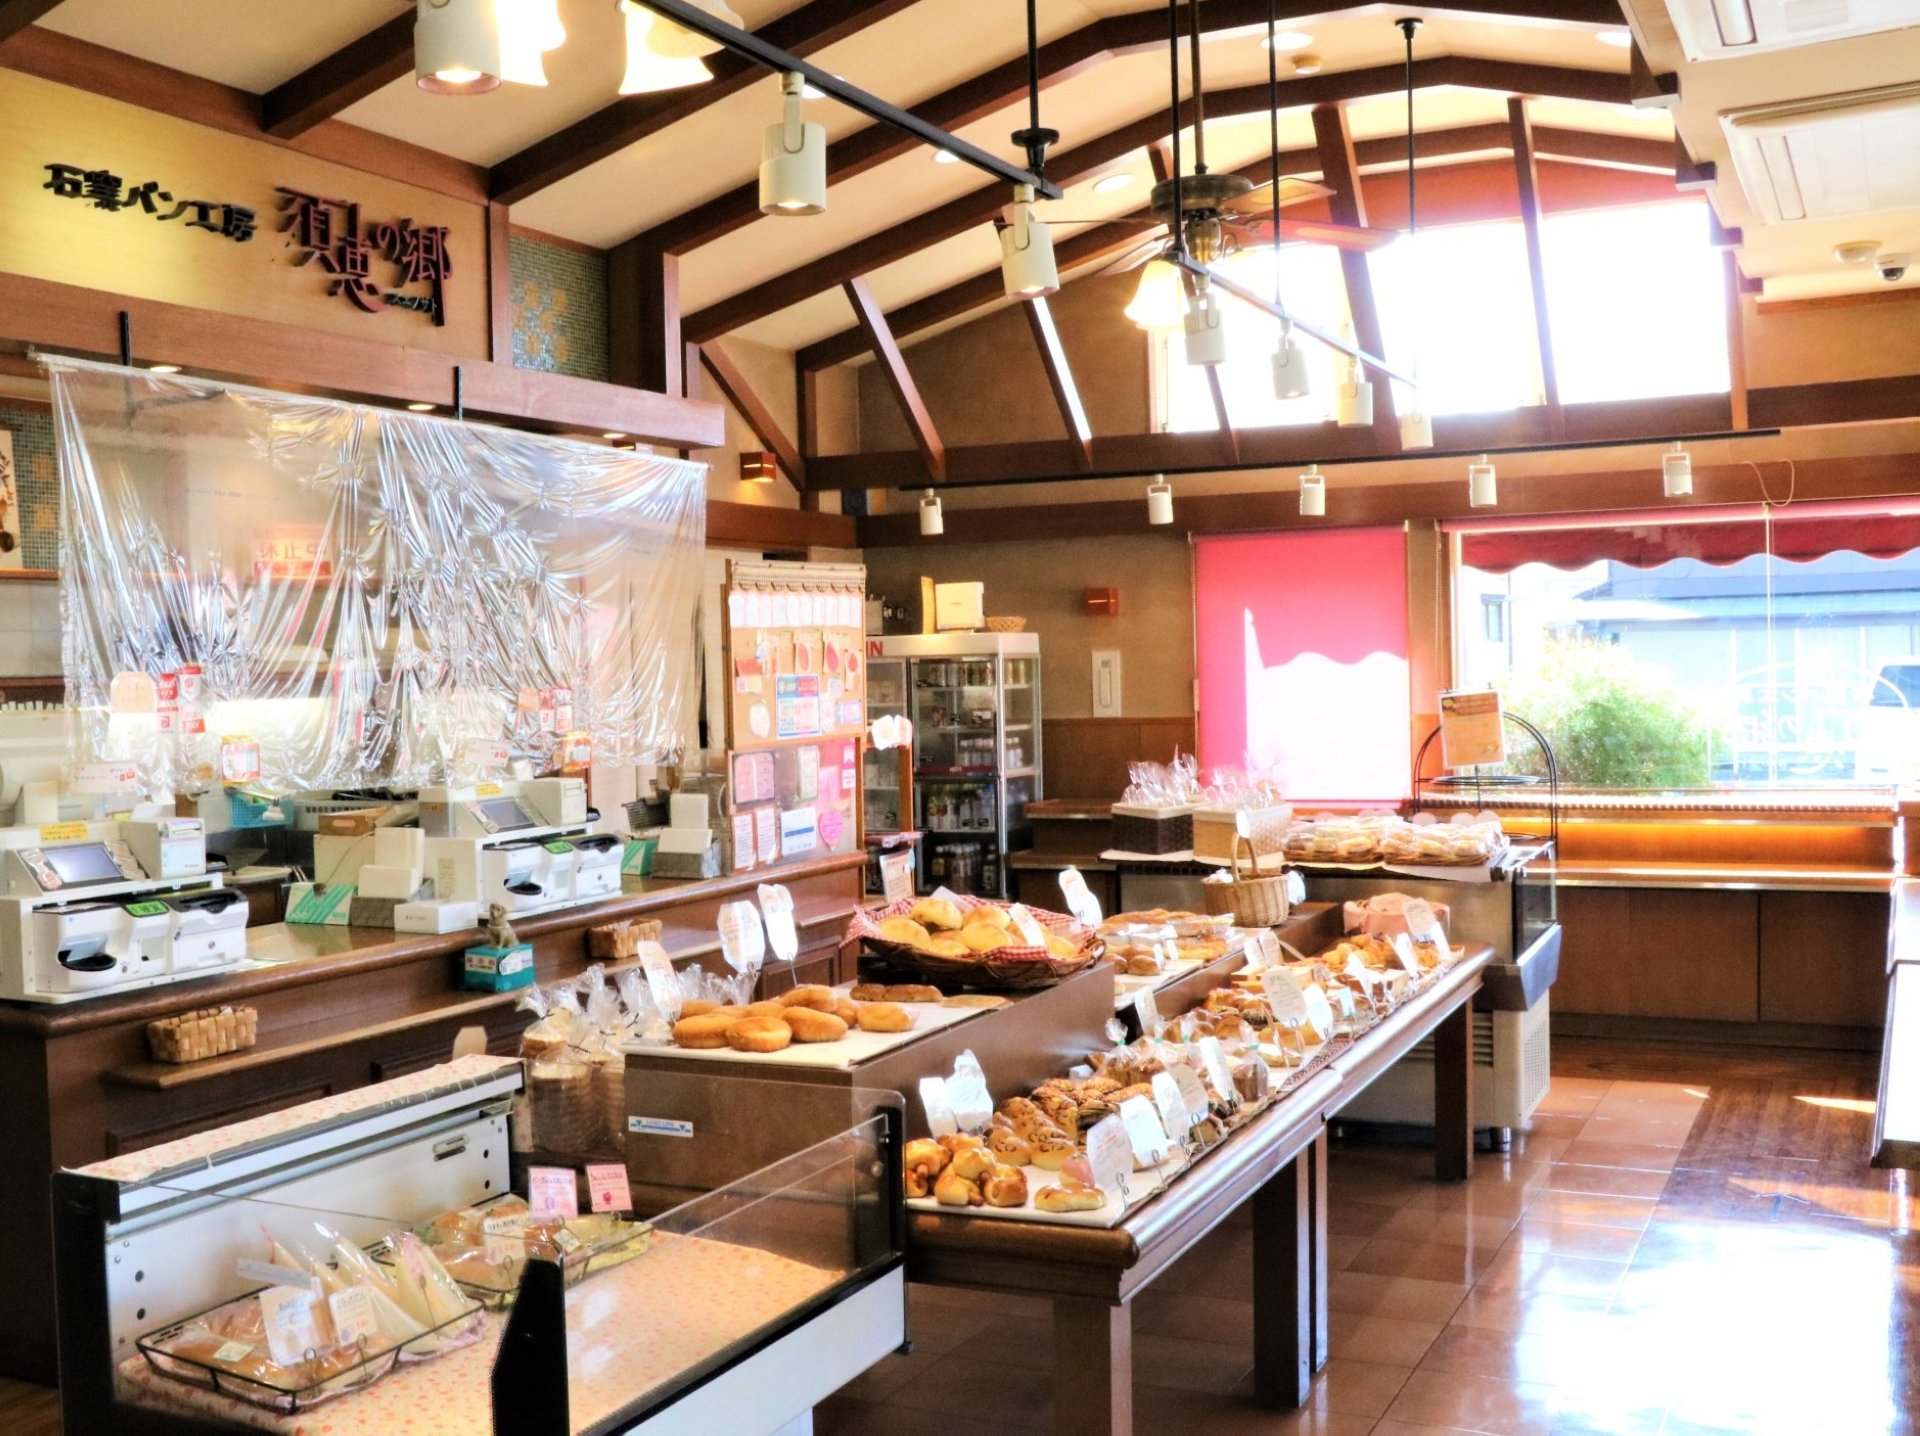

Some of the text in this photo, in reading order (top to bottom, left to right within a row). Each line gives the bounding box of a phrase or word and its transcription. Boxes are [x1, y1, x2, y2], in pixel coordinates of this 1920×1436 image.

[43, 162, 454, 327] 石窯パン工房 須恵の郷
